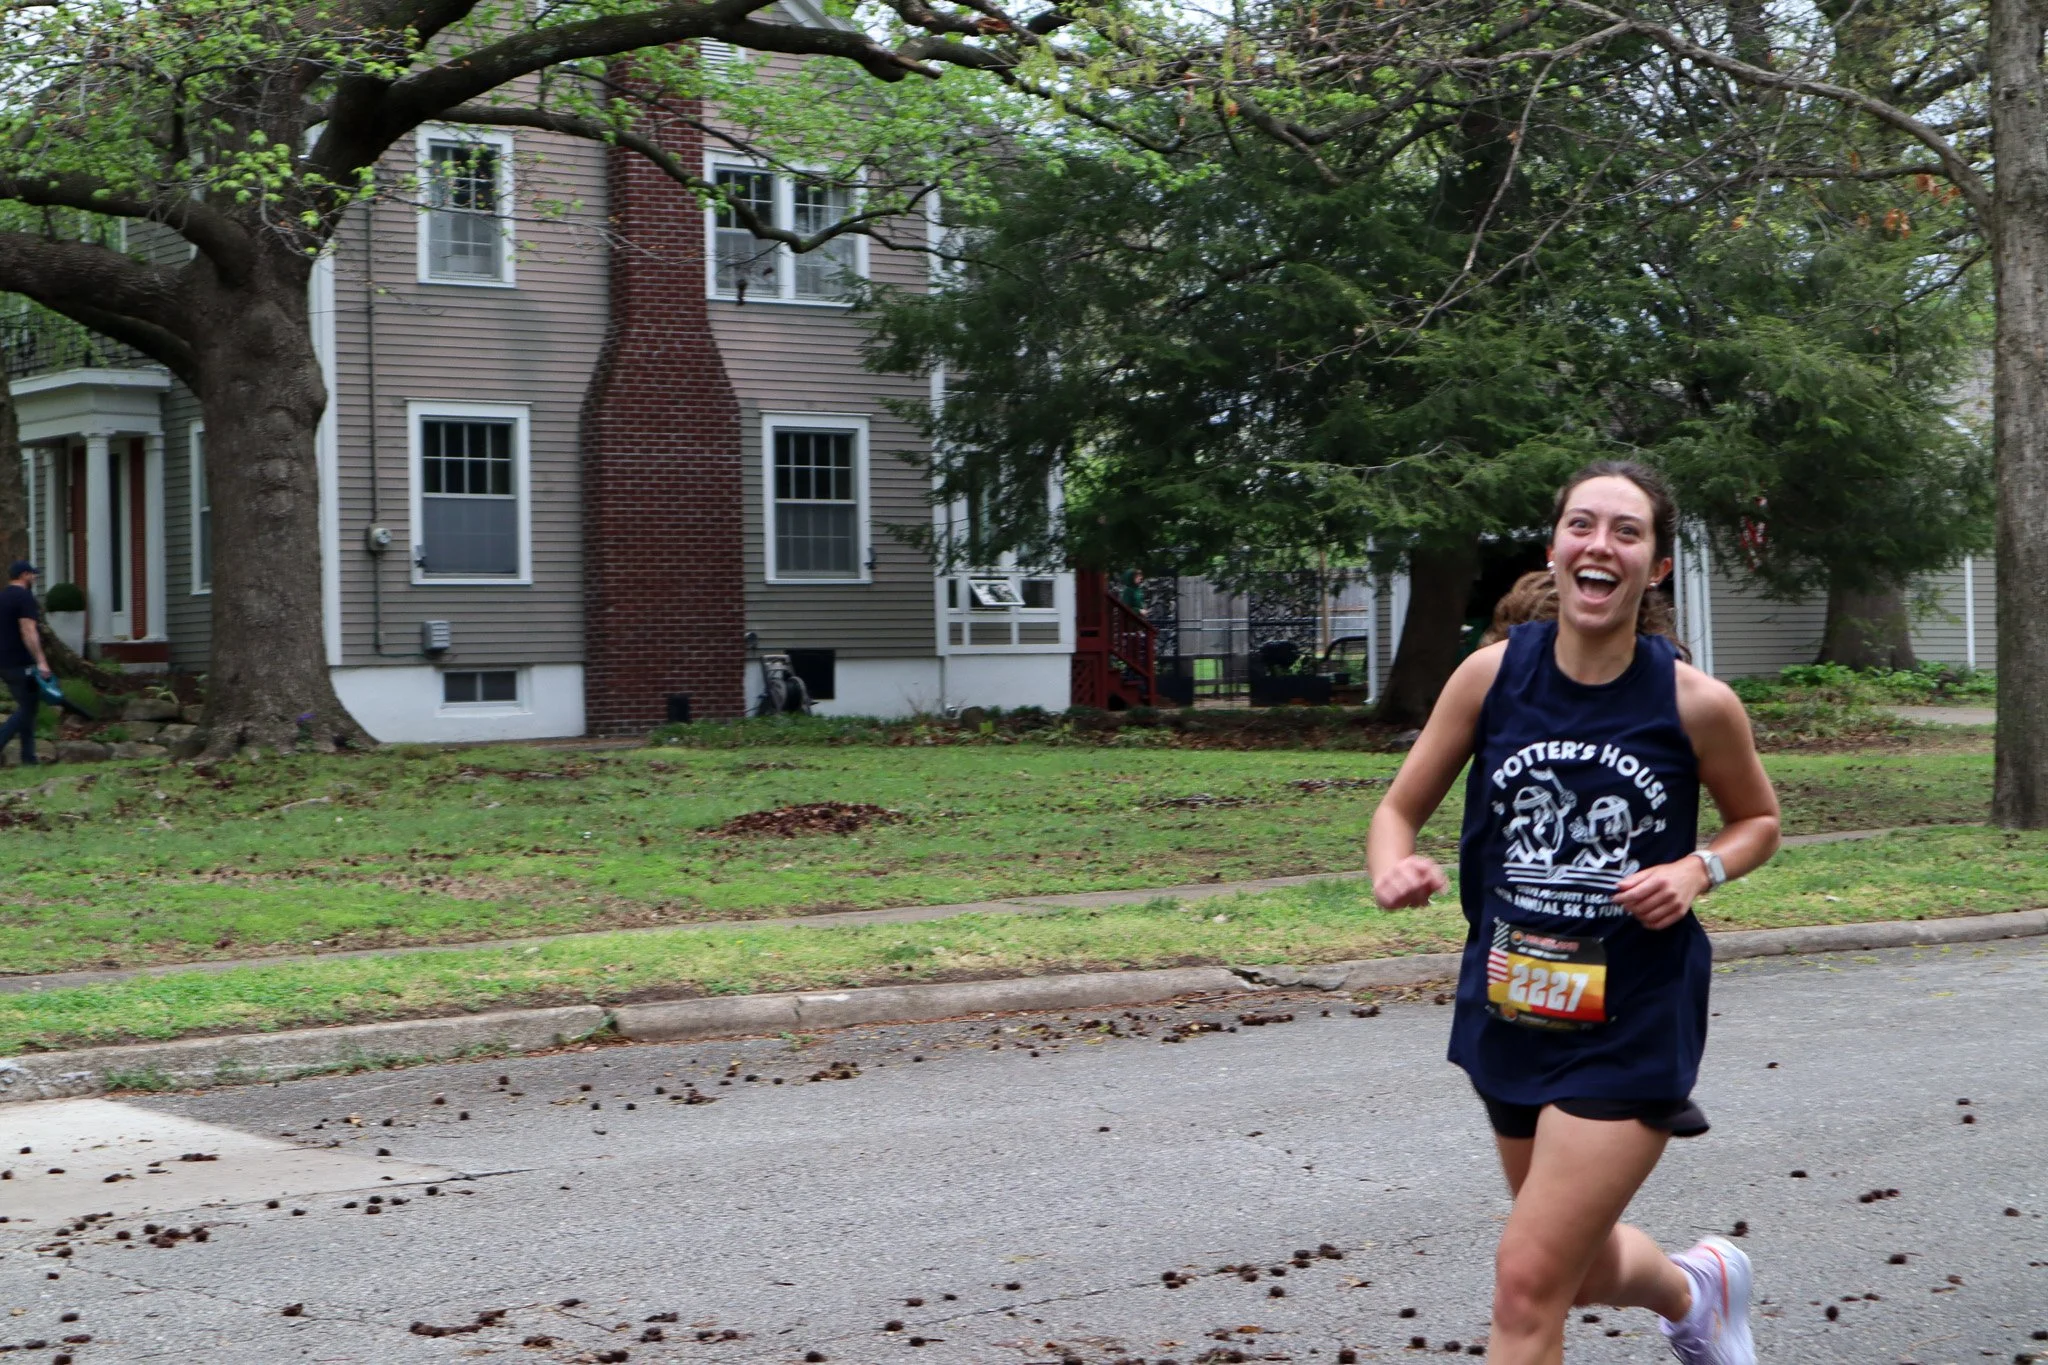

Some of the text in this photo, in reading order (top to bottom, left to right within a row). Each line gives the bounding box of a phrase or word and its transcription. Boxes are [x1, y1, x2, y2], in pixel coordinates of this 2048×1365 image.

[1492, 741, 1668, 810] POTTER'S HOUSE
[1514, 894, 1561, 915] ANNUAL
[1562, 904, 1582, 917] 5K
[1584, 905, 1597, 919] &
[1508, 963, 1589, 1012] 2227
